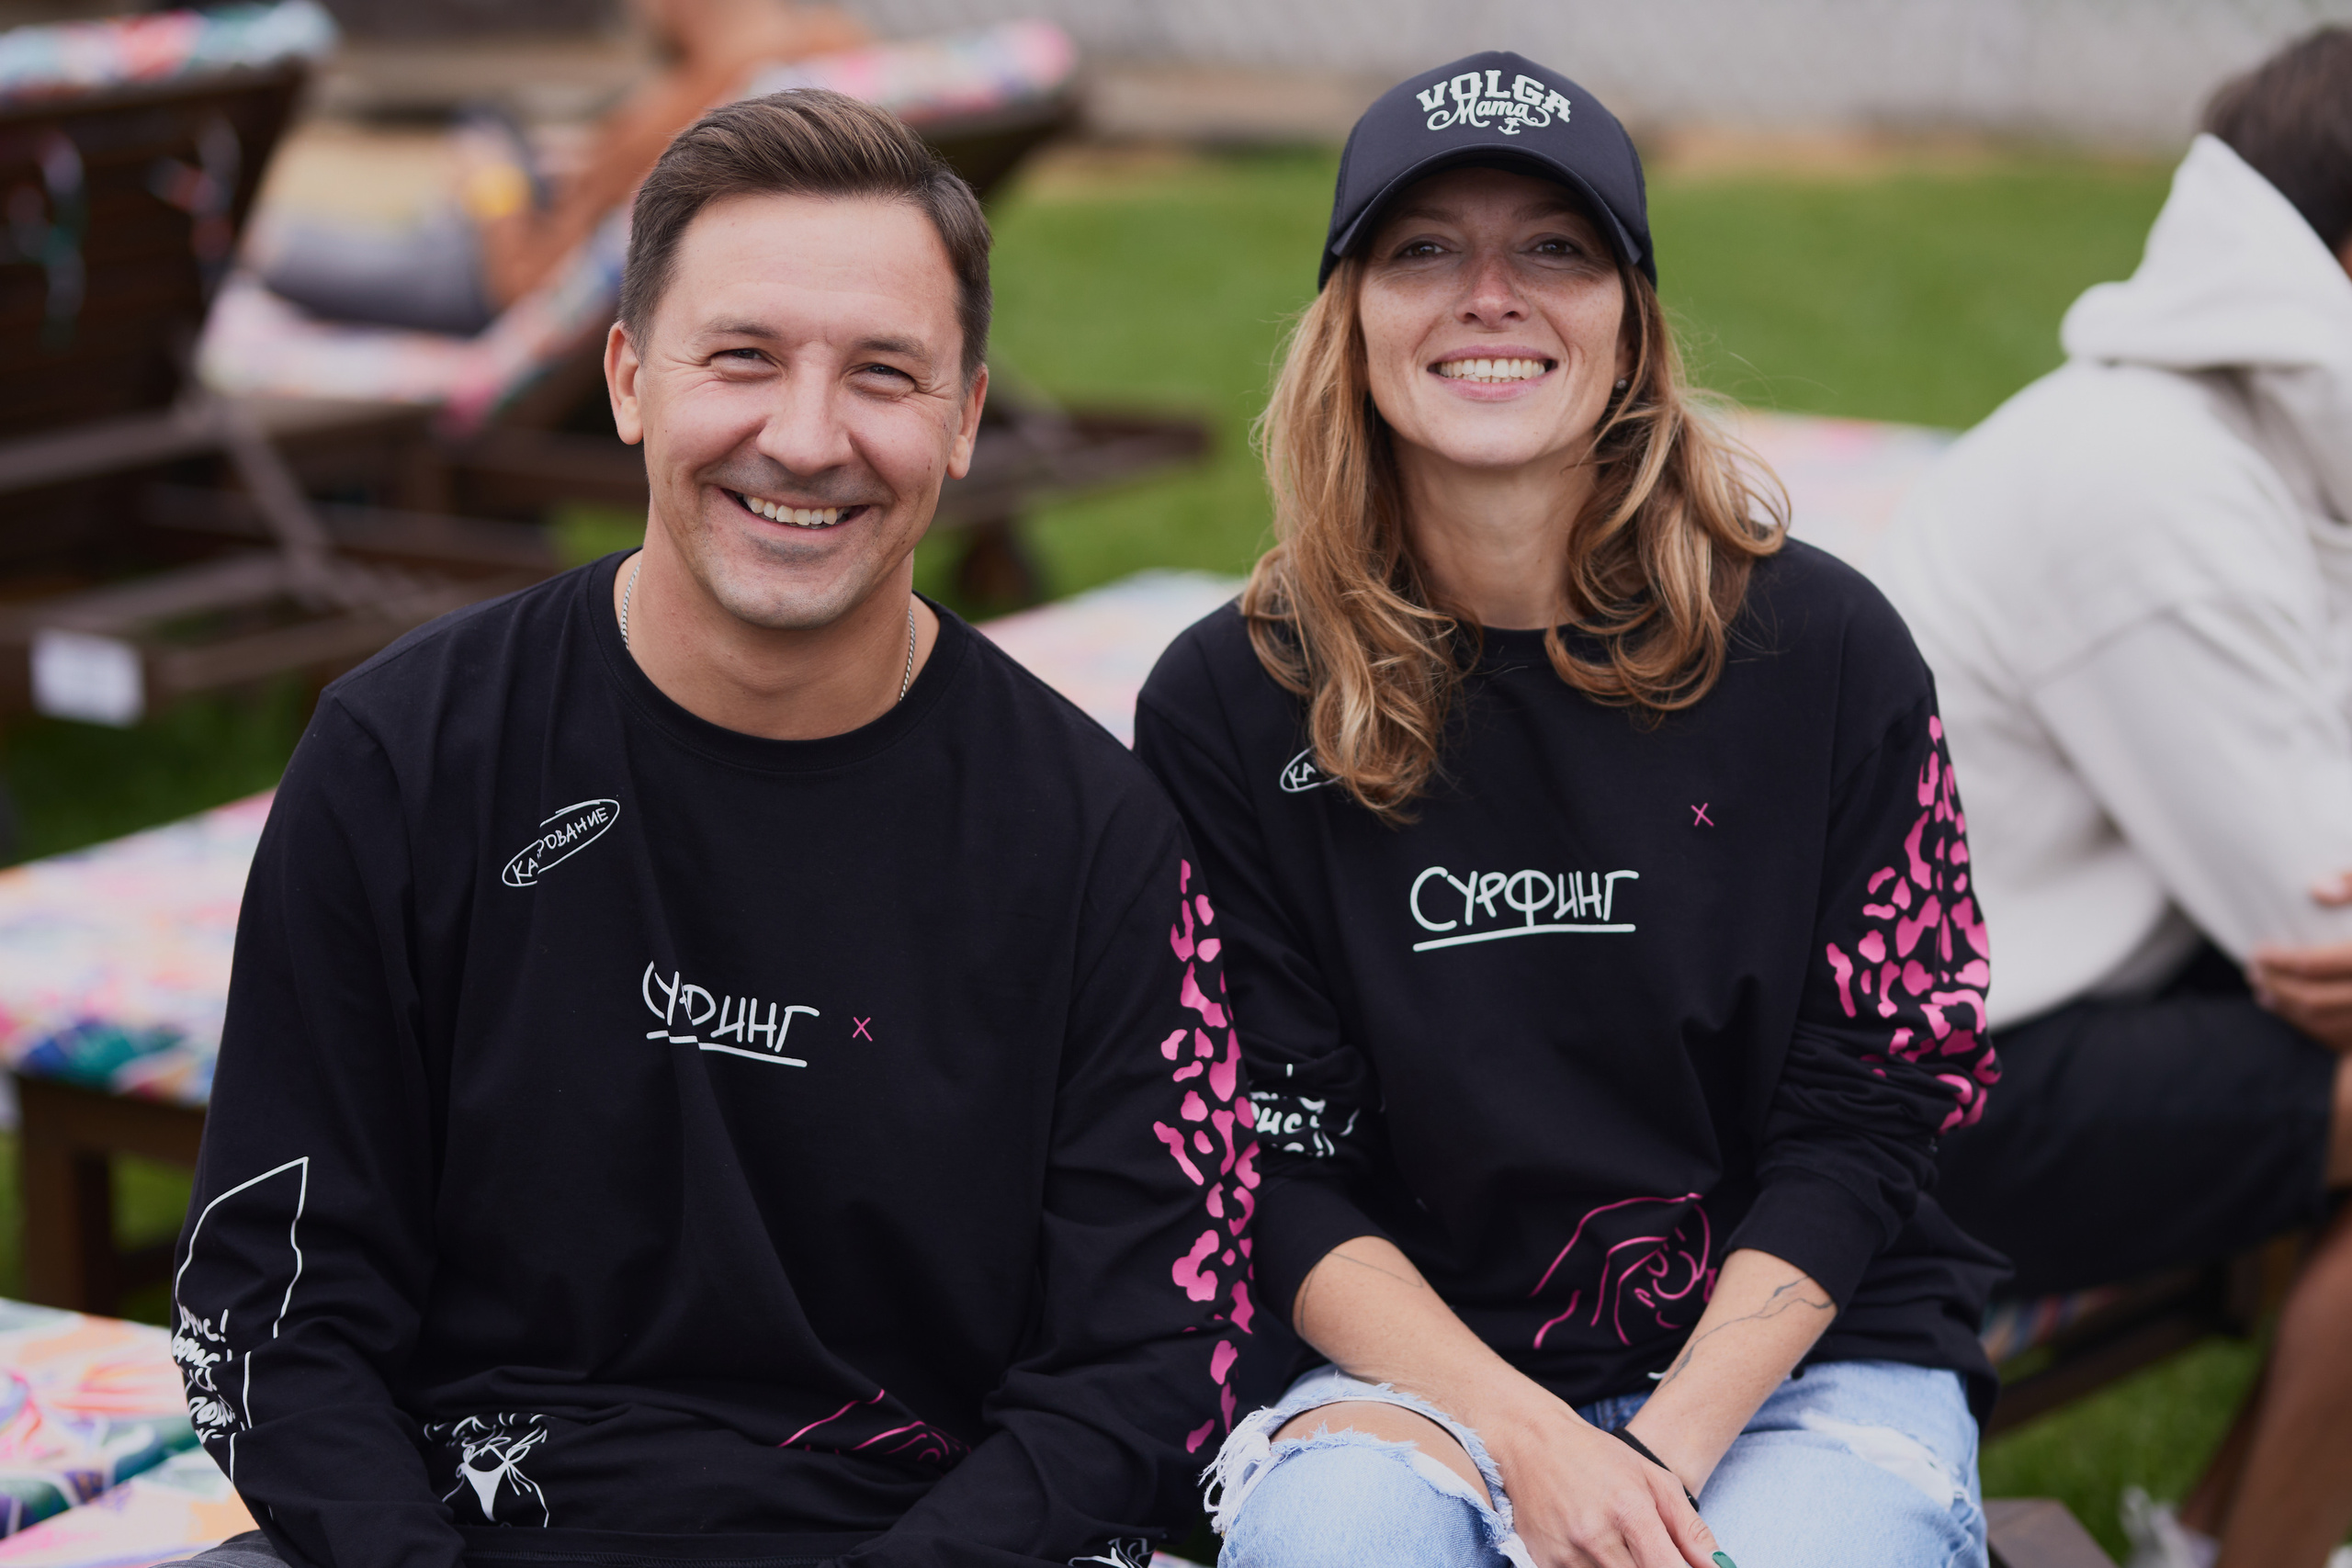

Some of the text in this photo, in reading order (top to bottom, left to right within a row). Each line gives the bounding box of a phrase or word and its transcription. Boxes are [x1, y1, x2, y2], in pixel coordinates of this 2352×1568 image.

[1416, 70, 1571, 123] VOLGA
[1426, 96, 1551, 130] Mama
[1409, 866, 1640, 932] СУРФИНГ
